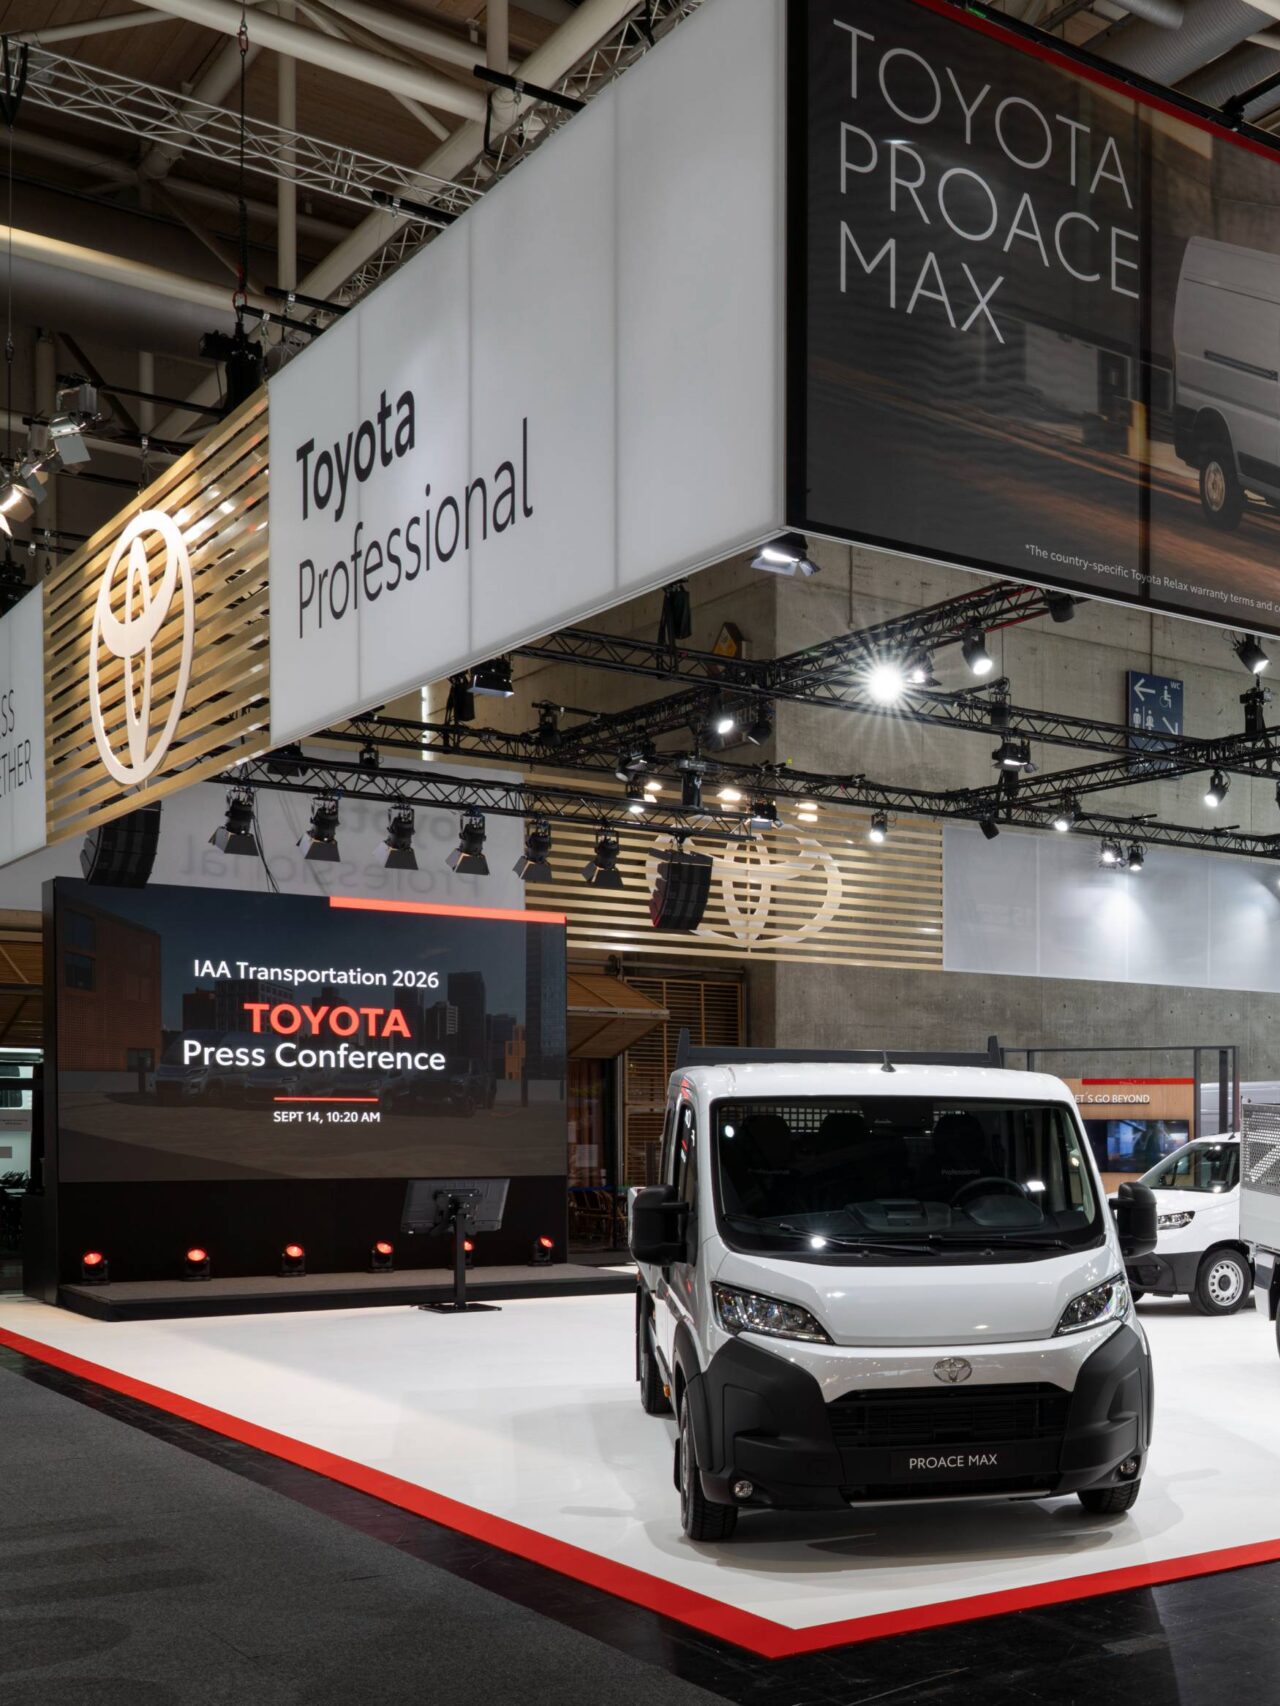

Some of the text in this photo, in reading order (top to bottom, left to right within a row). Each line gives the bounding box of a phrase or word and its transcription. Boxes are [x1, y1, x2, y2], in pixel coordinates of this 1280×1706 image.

[833, 19, 1133, 210] TOYOTA
[840, 121, 1139, 300] PROACE
[840, 220, 1006, 345] MAX
[296, 389, 416, 523] Toyota
[299, 416, 534, 639] Professional
[1051, 551, 1129, 578] country-specific
[1131, 569, 1162, 585] Toyota
[1163, 576, 1189, 592] Relax
[1190, 585, 1229, 603] warranty
[1230, 593, 1255, 607] terms
[1256, 601, 1273, 611] and
[1170, 681, 1181, 690] WC
[194, 959, 440, 988] IAA Transportation 2026
[243, 1002, 412, 1038] TOYOTA
[183, 1040, 447, 1070] Press Conference
[1095, 1094, 1110, 1103] GO
[1112, 1094, 1150, 1104] BEYOND
[273, 1111, 381, 1125] SEPT 14, 10:20 AM
[909, 1453, 998, 1470] PROACE MAX
